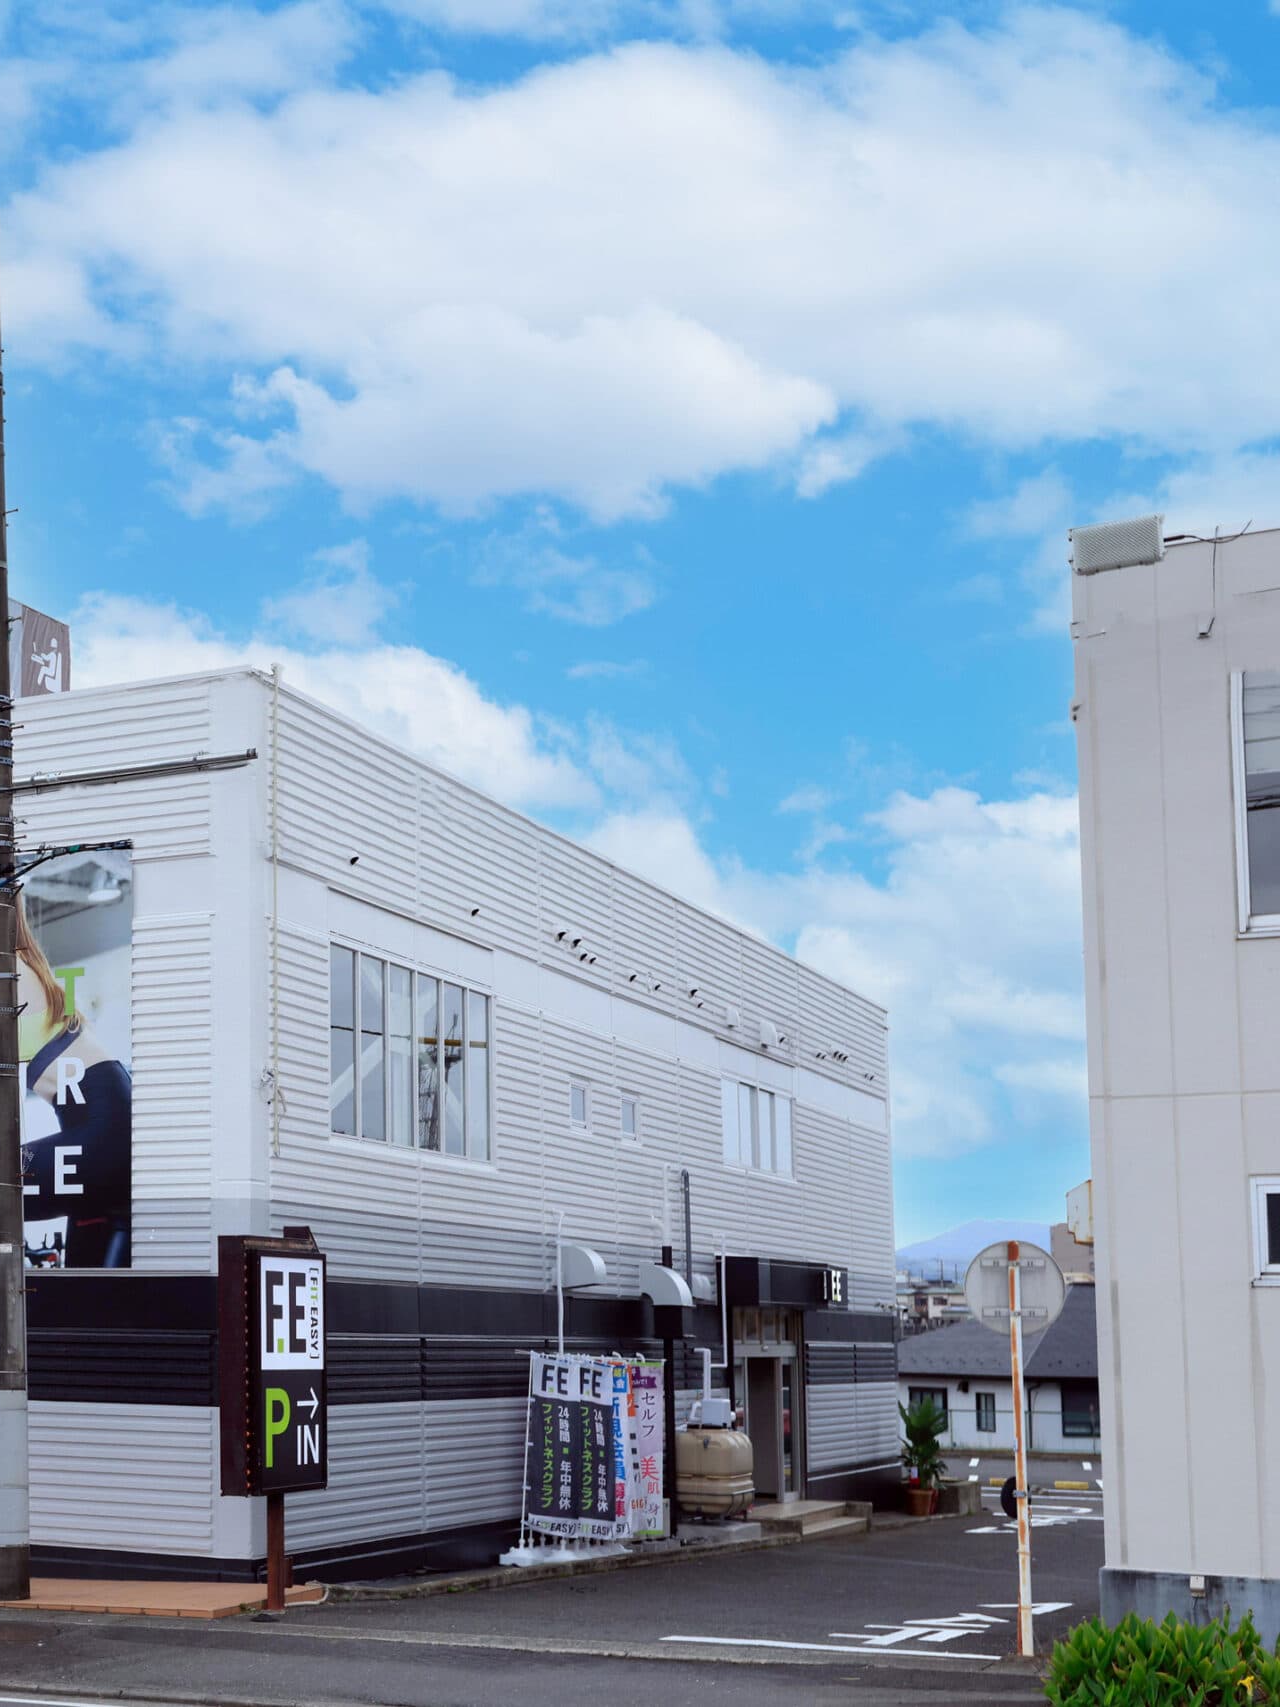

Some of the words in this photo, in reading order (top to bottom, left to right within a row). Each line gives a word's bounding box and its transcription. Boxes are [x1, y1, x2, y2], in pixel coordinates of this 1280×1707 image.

[265, 1388, 291, 1468] P
[641, 1392, 657, 1438] セルフ
[297, 1424, 320, 1466] IN
